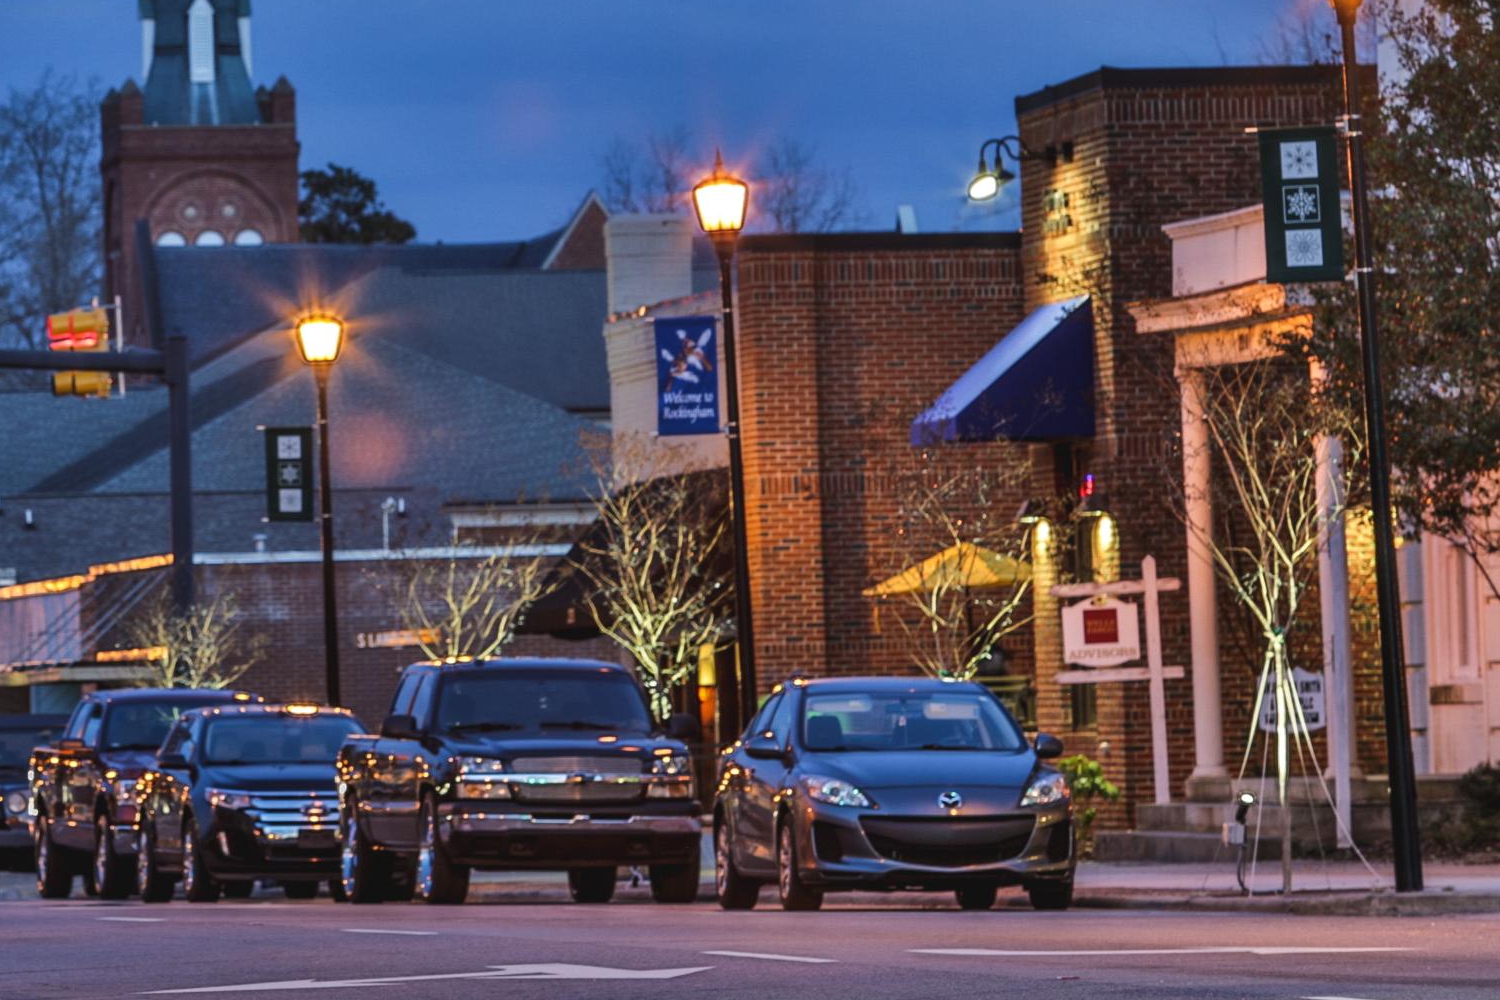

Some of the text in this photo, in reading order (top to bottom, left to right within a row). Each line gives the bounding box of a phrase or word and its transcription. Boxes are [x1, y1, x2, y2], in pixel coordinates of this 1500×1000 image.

[663, 389, 702, 404] Welcome
[663, 405, 715, 424] Rockingham
[1069, 647, 1137, 659] ADVISORS
